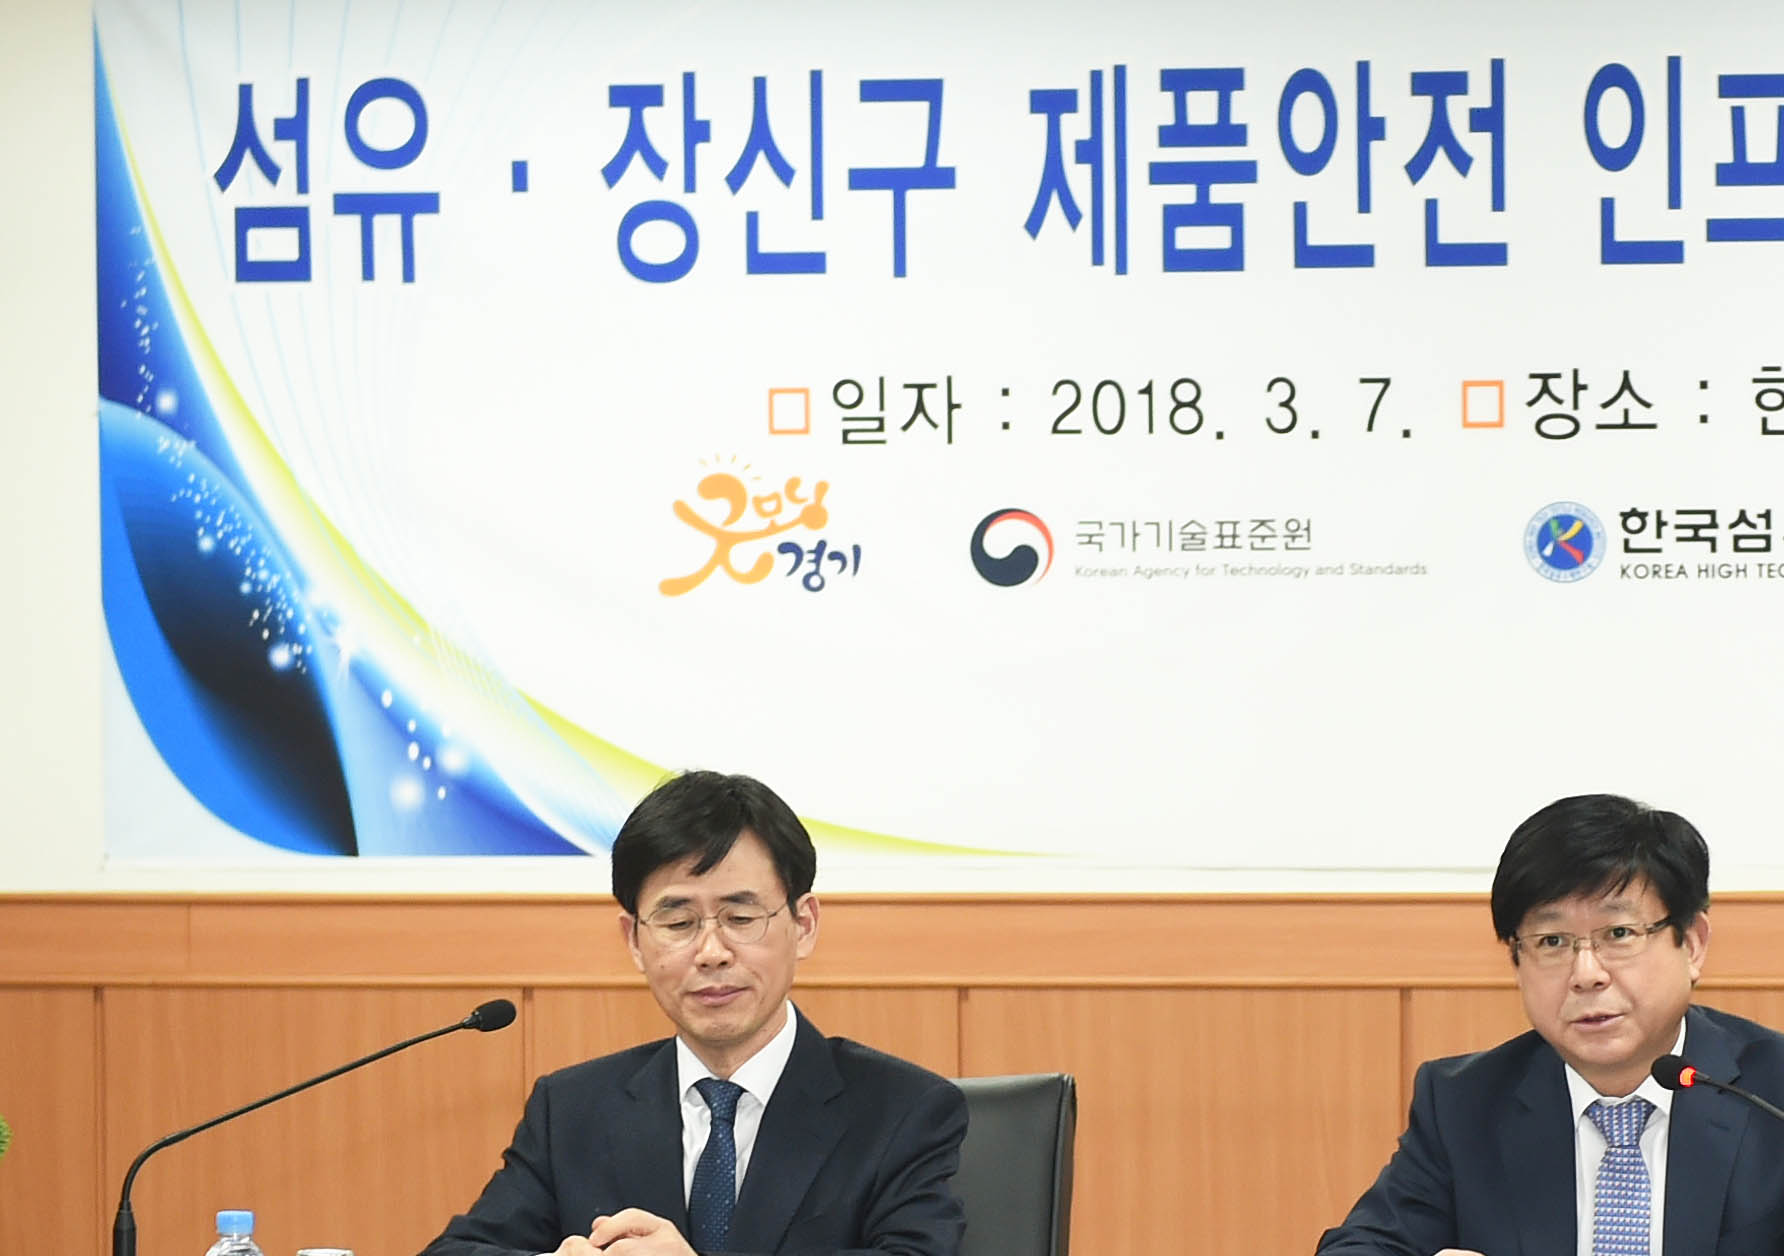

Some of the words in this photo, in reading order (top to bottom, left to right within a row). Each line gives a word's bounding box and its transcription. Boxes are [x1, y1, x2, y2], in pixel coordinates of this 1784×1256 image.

[212, 76, 441, 284] 섬유
[600, 68, 957, 284] 장신구
[1023, 57, 1509, 276] 제품안전
[832, 374, 963, 446] 일자
[1050, 377, 1225, 441] 2018.
[1265, 376, 1321, 440] 3.
[1358, 376, 1412, 439] 7.
[1524, 367, 1659, 441] 장소
[1075, 517, 1312, 553] 국가기술표준원
[777, 539, 861, 593] 경기
[1074, 565, 1128, 577] Korean
[1133, 564, 1190, 579] Agency
[1194, 563, 1216, 577] for
[1223, 562, 1311, 579] Technology
[1314, 563, 1345, 577] and
[1349, 561, 1428, 577] Standards
[1619, 562, 1689, 580] KOREA
[1697, 562, 1748, 580] HIGH
